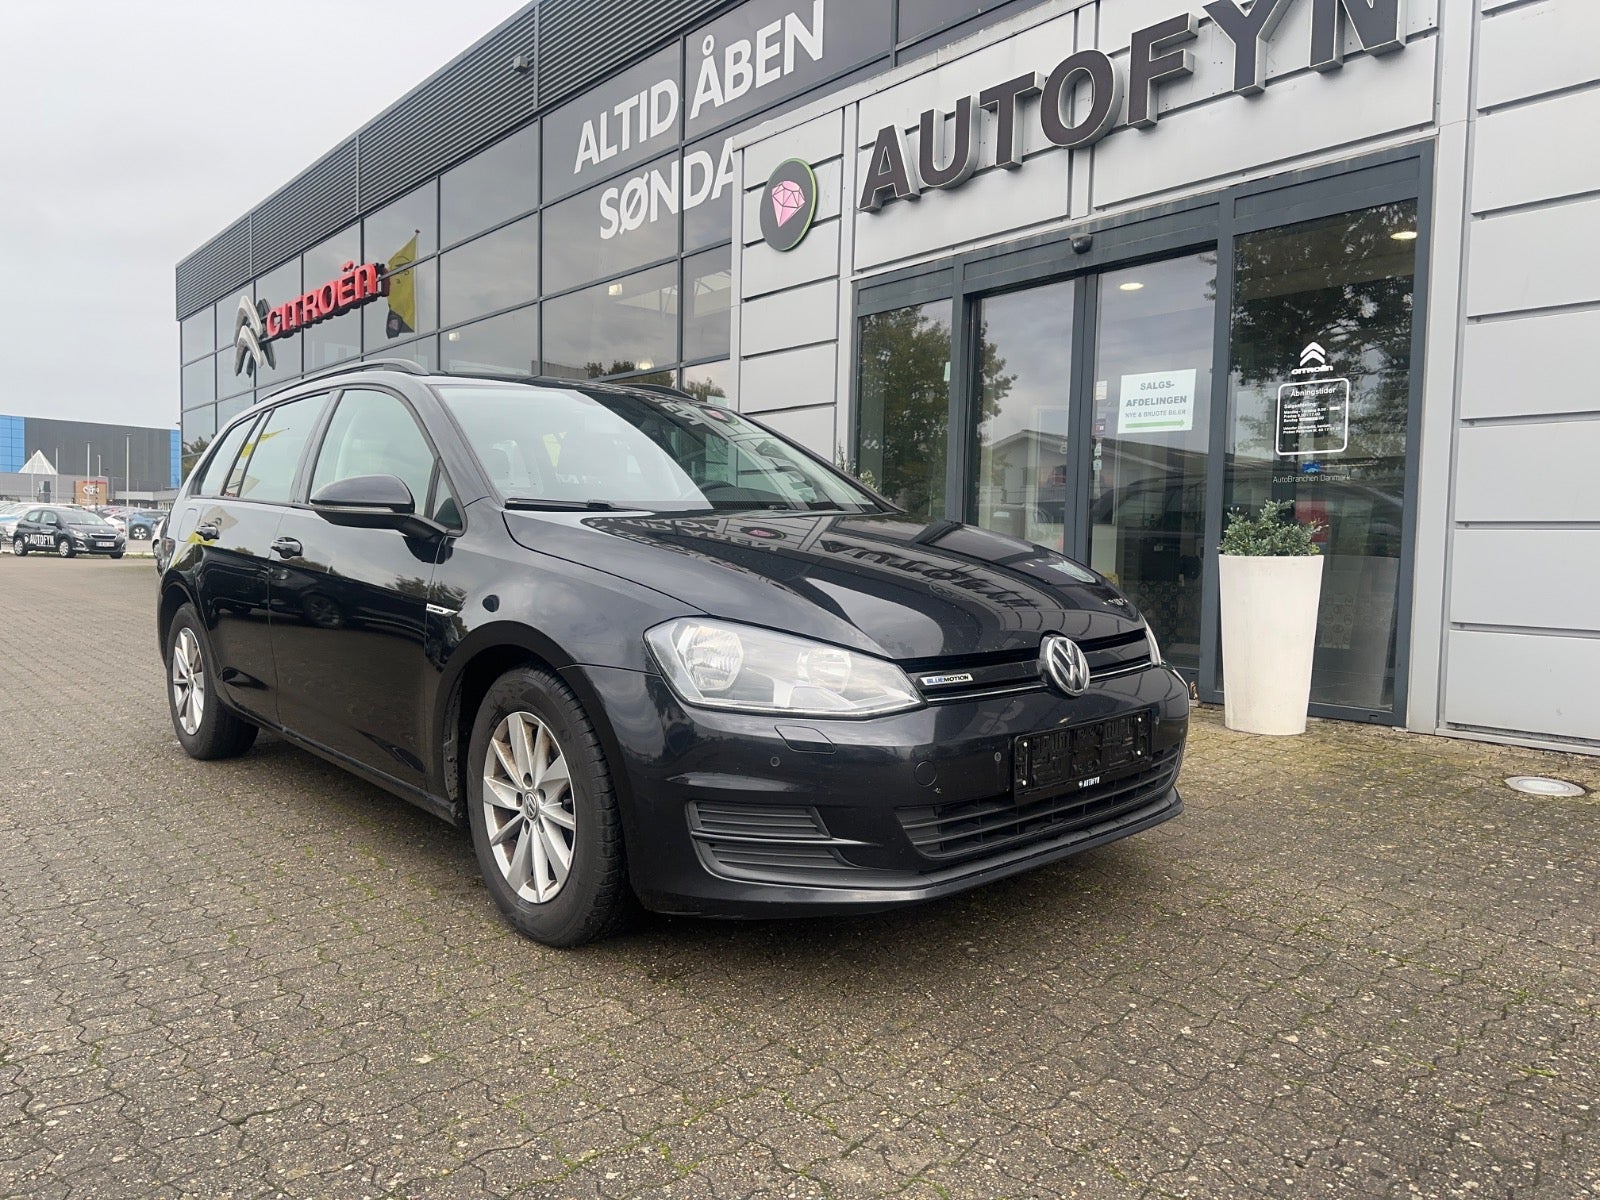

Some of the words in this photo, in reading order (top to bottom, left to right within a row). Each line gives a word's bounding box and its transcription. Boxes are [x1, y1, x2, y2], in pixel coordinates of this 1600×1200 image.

[574, 79, 679, 175] ALTID
[690, 0, 824, 119] ÅBEN
[859, 0, 1405, 212] AUTOFYN
[600, 137, 733, 240] SØNDA
[1140, 380, 1175, 391] SALGS-
[1290, 387, 1336, 397] Åbningstider
[1126, 395, 1187, 407] AFDELINGEN
[1273, 475, 1319, 483] AutoBranchen
